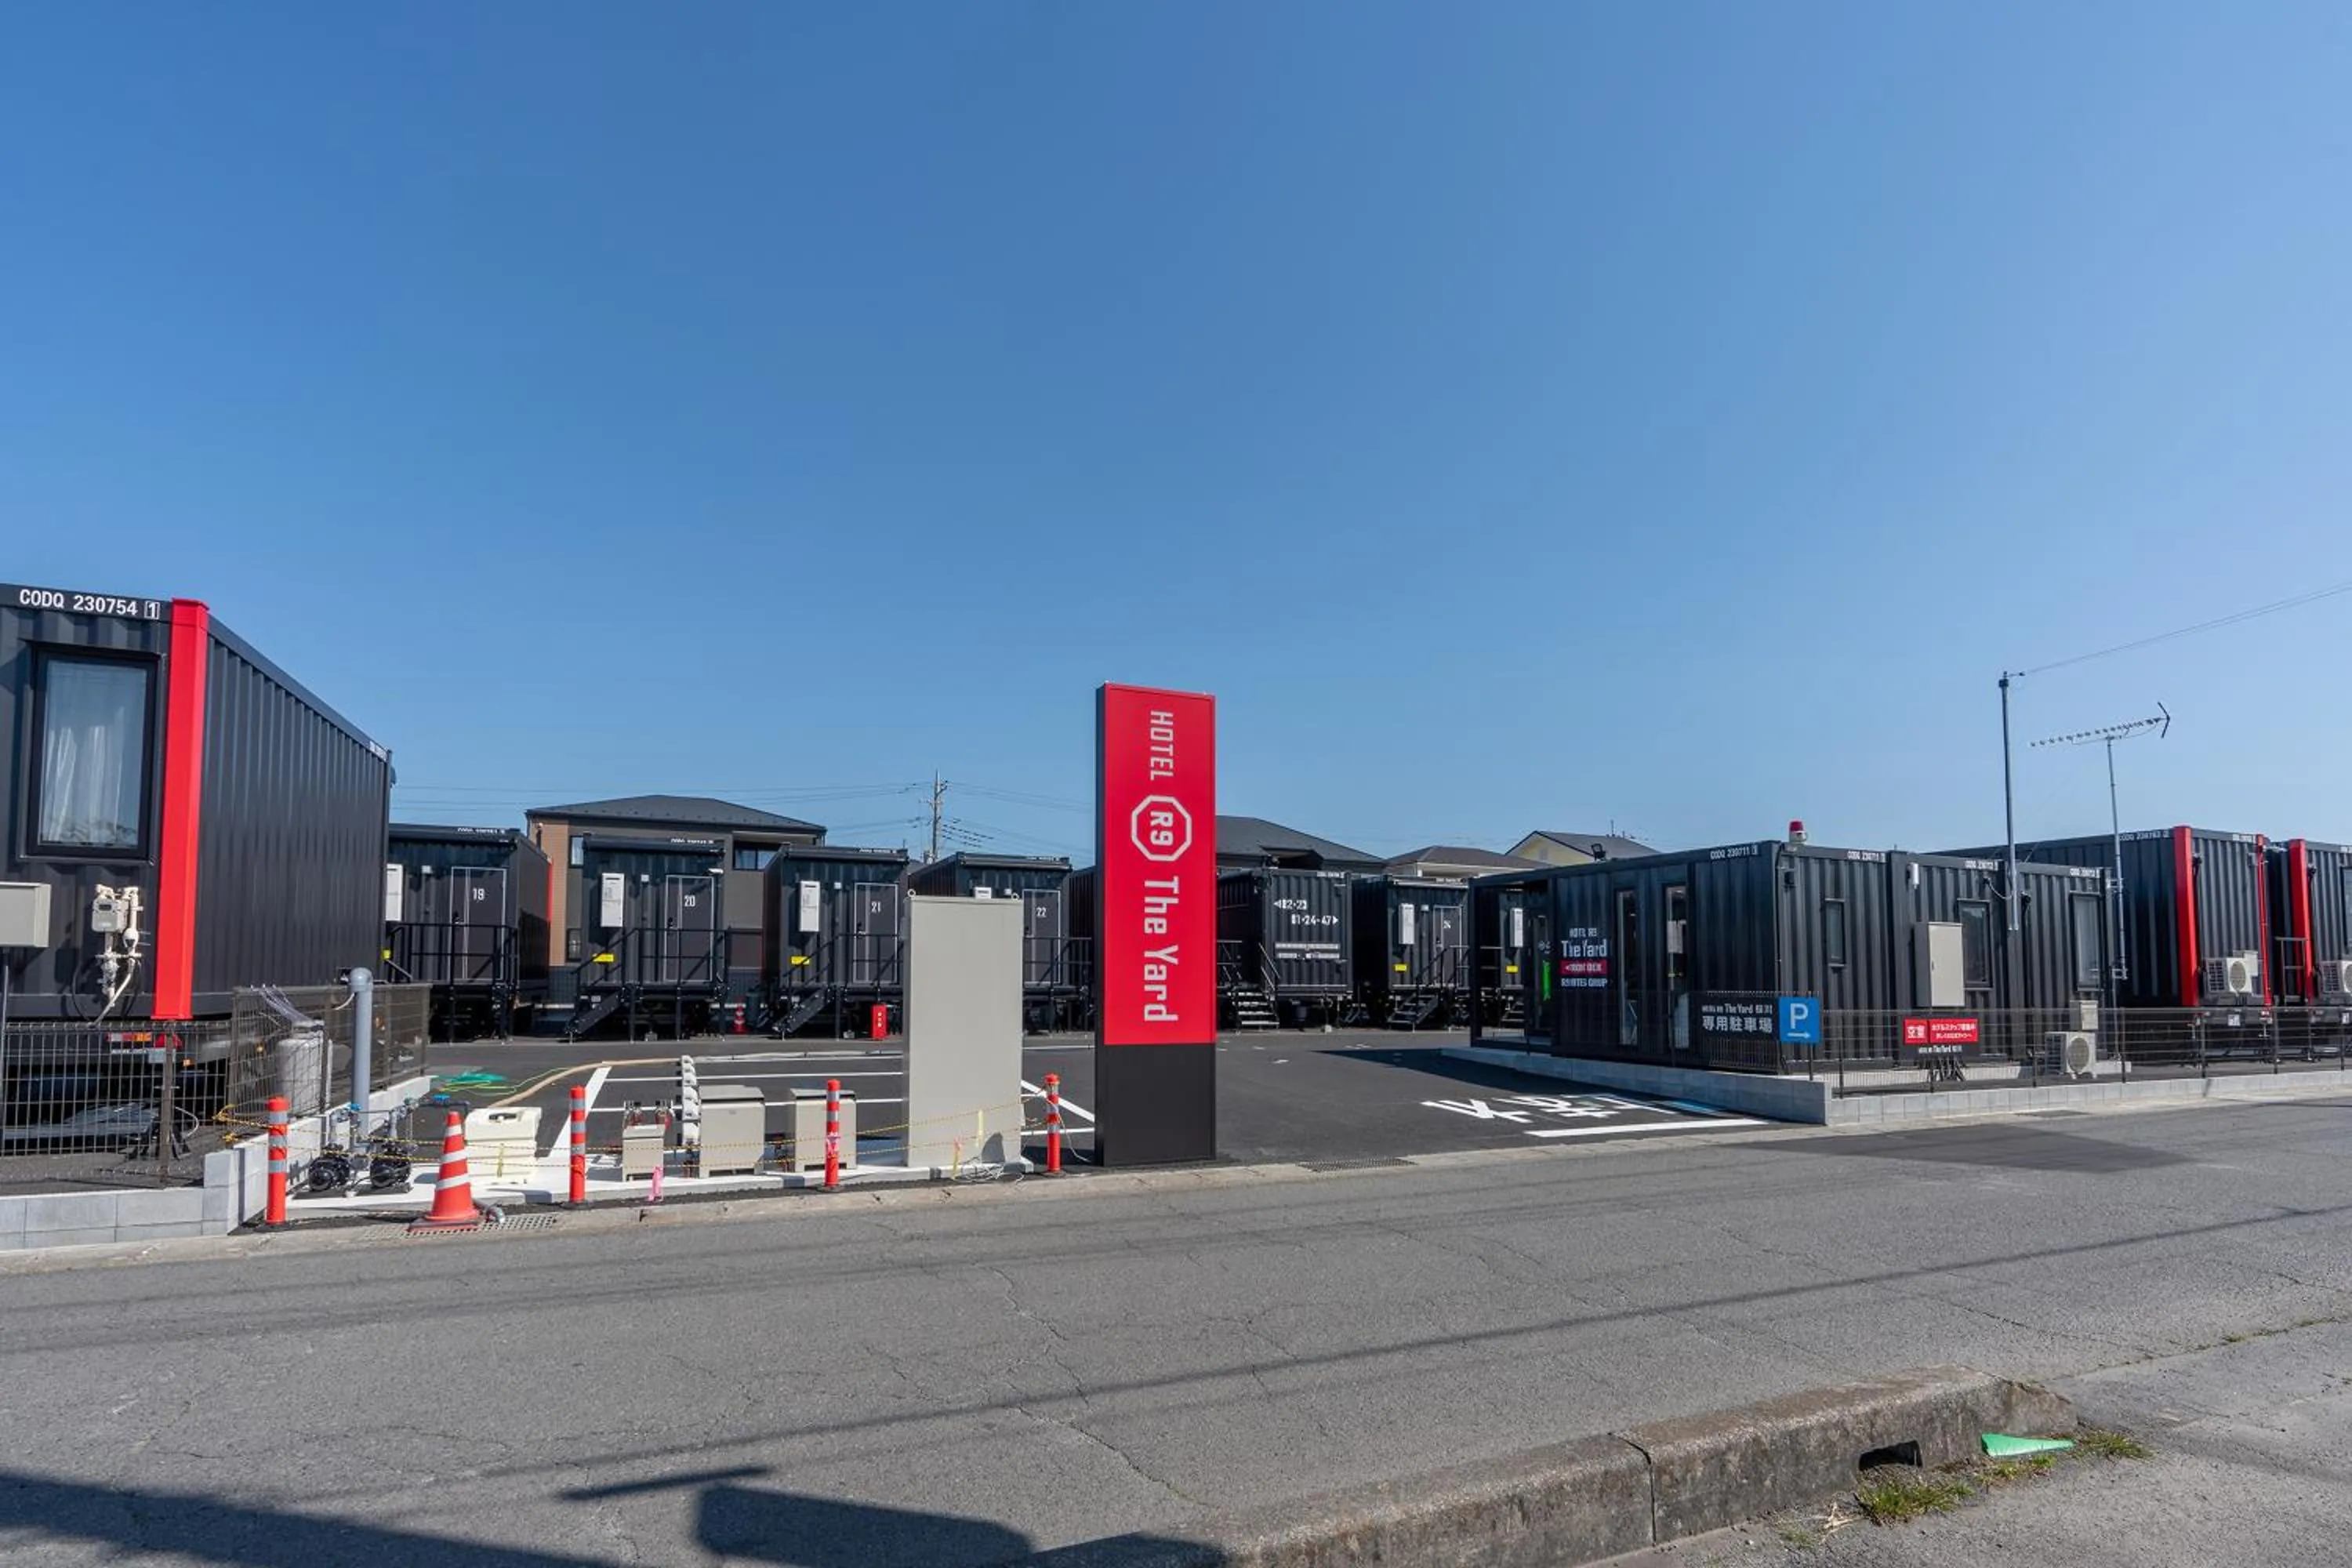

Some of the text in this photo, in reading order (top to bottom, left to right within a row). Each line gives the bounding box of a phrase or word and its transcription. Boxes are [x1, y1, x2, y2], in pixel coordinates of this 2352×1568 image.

[20, 589, 64, 608] CODQ
[73, 595, 138, 615] 230754
[1144, 710, 1179, 1022] HOTEL R9 The Yard
[684, 895, 695, 907] 20
[871, 902, 881, 913] 21
[1036, 906, 1047, 917] 22
[1790, 1003, 1809, 1029] P
